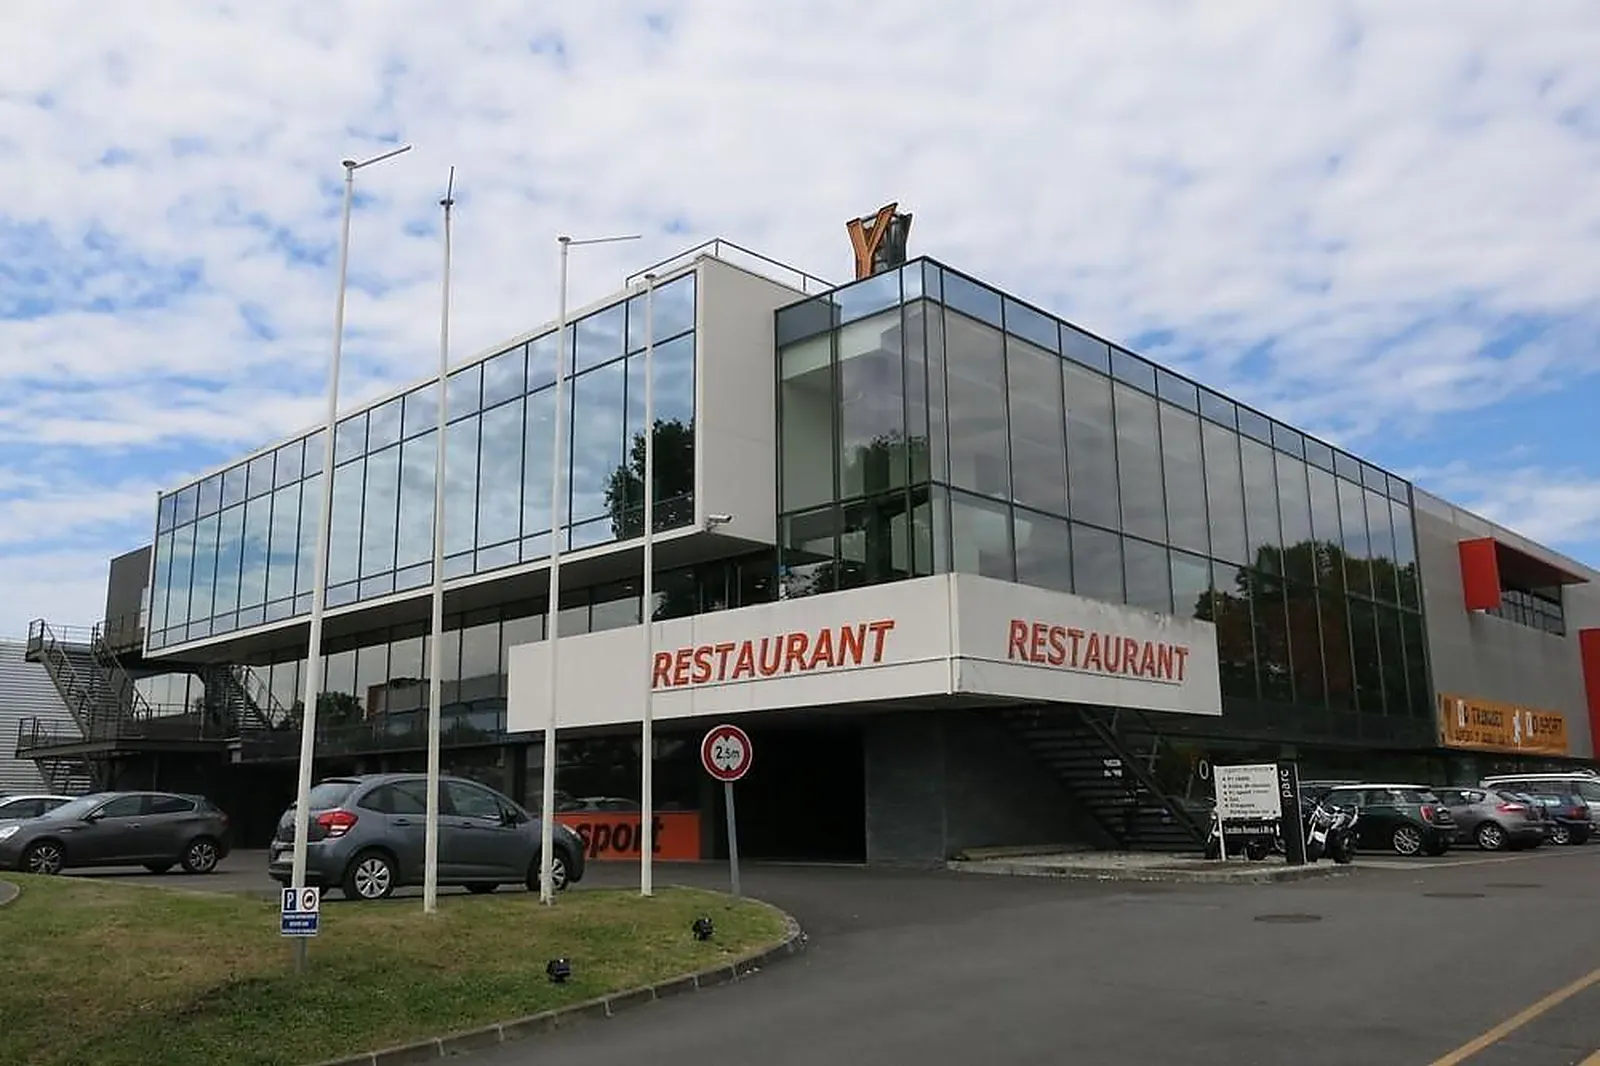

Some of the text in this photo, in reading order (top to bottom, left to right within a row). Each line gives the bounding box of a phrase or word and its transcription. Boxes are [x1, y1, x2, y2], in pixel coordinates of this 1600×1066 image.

[652, 620, 895, 689] RESTAURANT
[1008, 619, 1189, 681] RESTAURANT
[1280, 769, 1294, 798] parc
[287, 891, 295, 909] P
